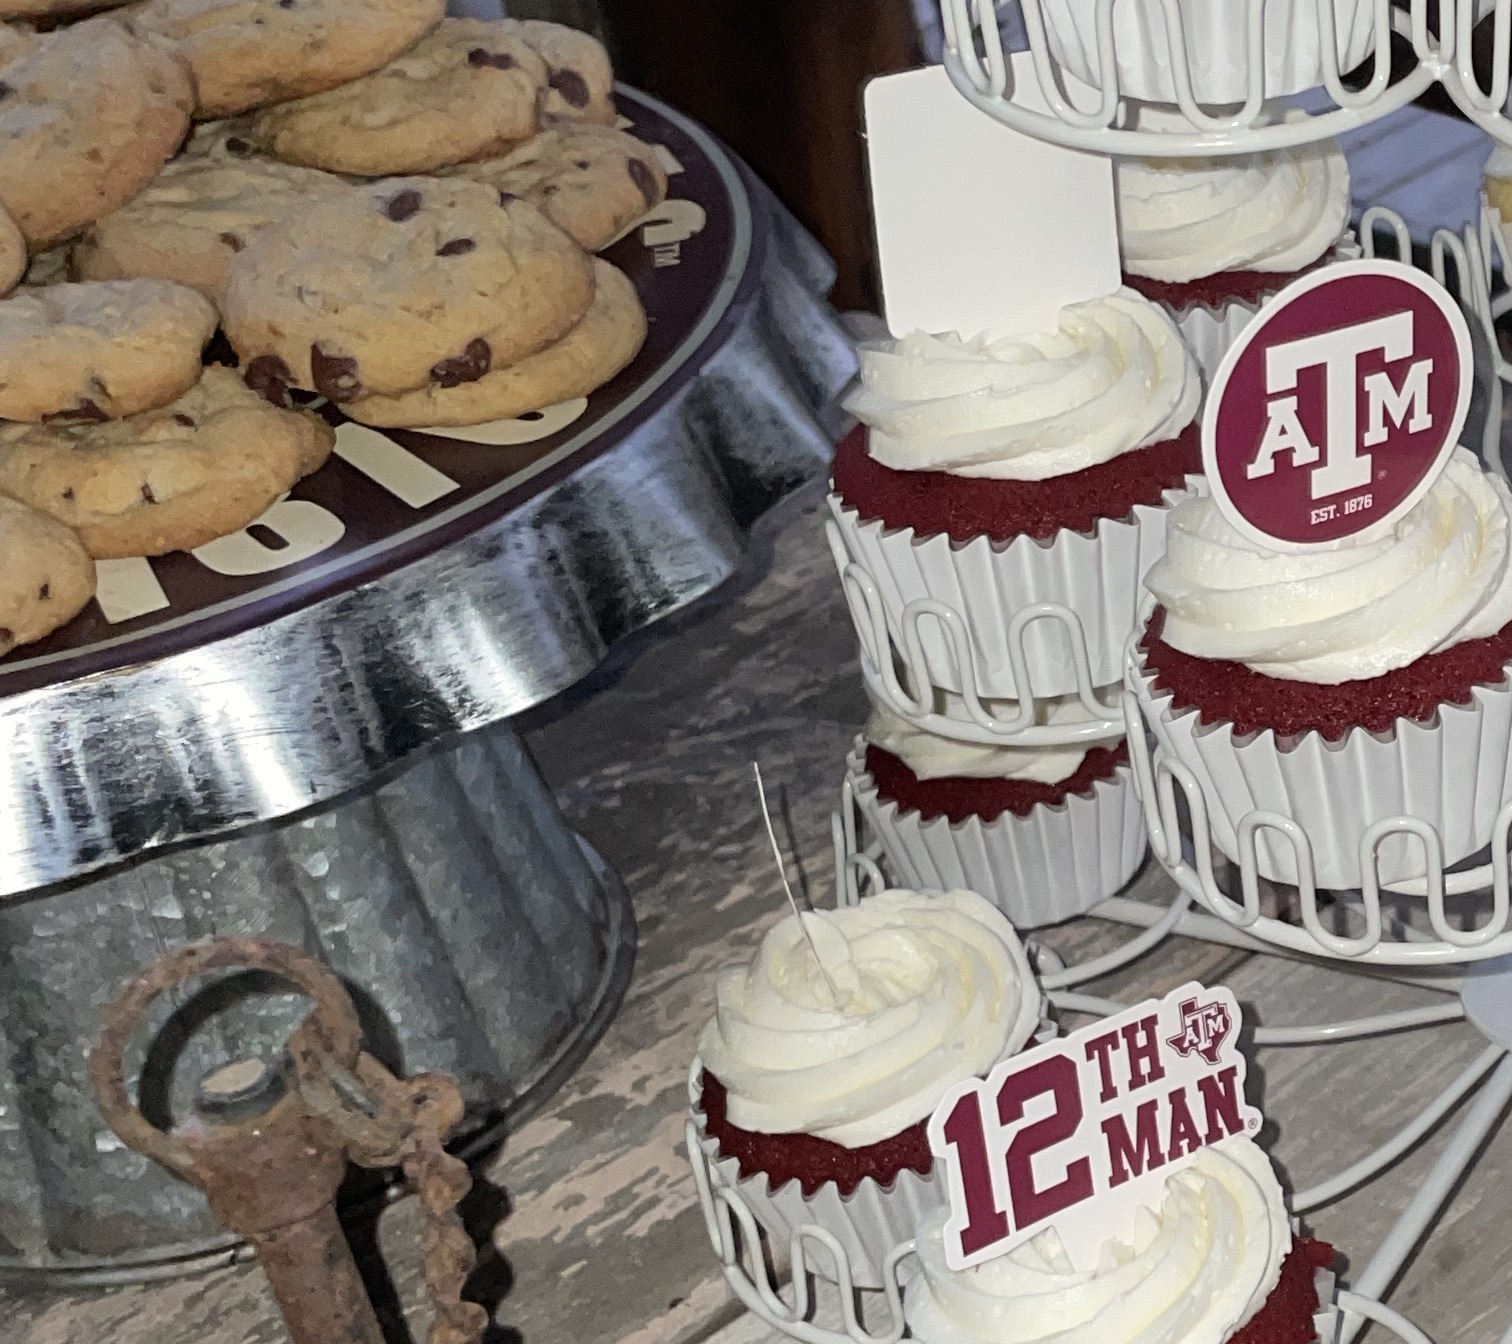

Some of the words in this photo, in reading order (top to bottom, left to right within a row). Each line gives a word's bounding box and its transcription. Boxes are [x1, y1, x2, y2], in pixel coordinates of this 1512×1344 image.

[1310, 504, 1341, 525] EST.
[1344, 494, 1374, 515] 1876
[1102, 1065, 1245, 1188] MAN
